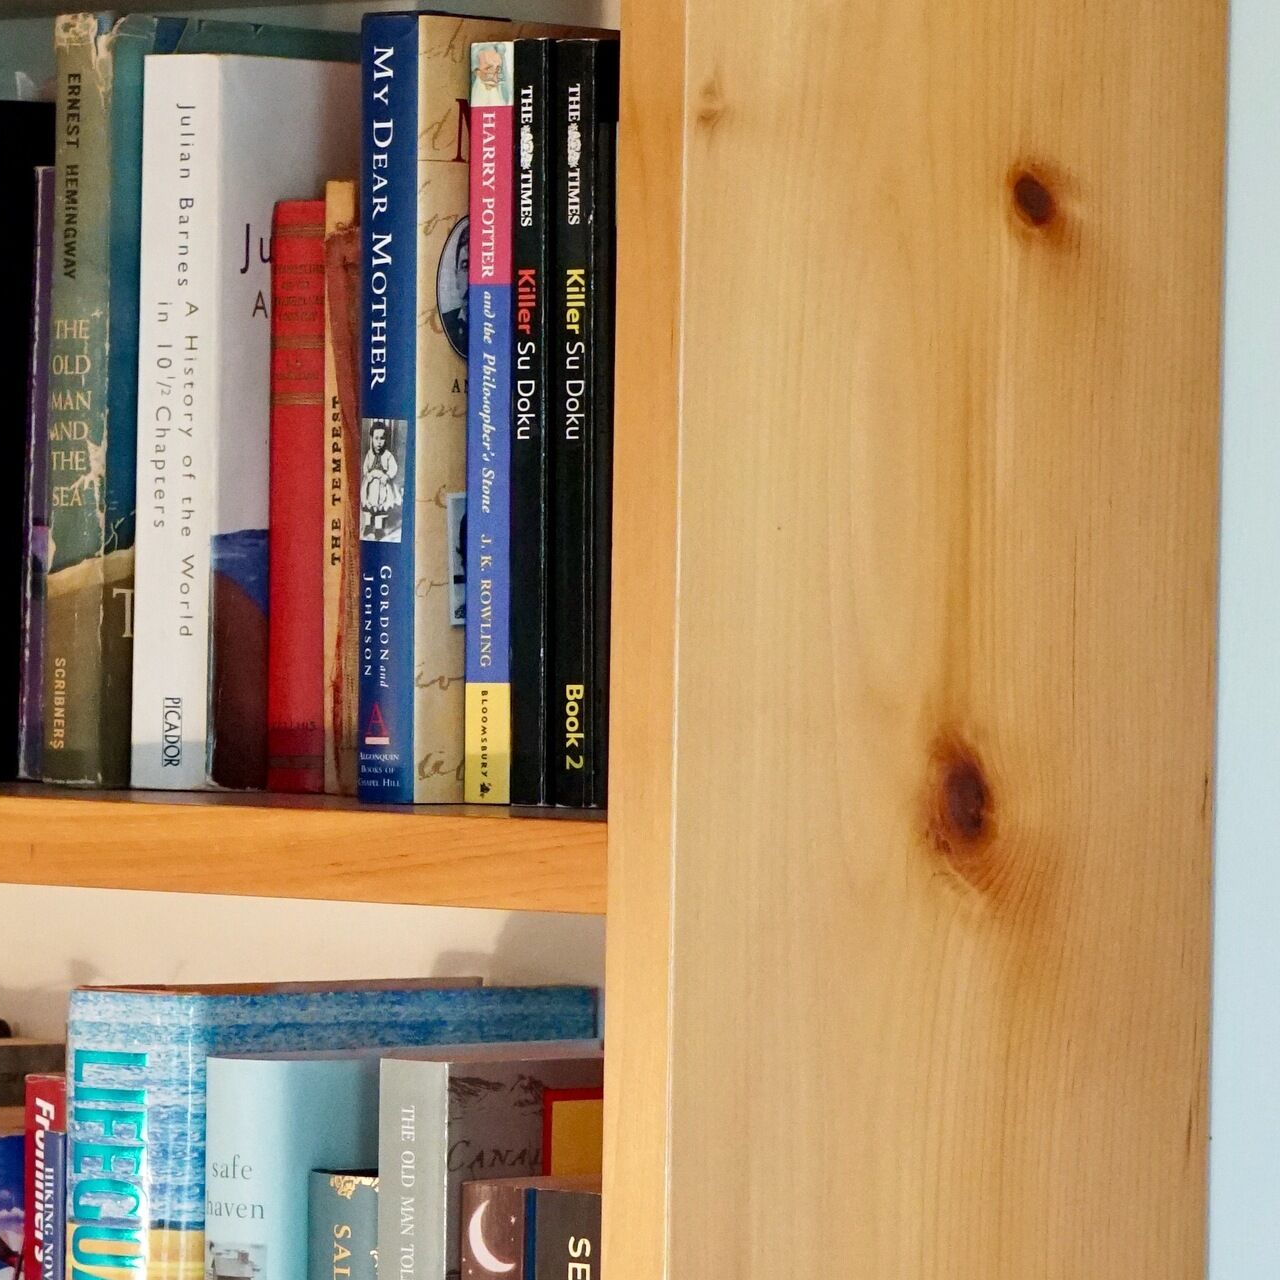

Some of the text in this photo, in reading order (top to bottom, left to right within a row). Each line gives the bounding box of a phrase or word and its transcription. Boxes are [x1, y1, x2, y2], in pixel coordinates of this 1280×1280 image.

[63, 72, 82, 280] ERNEST HEMINGWAY
[520, 84, 533, 227] THE TIMES
[567, 83, 581, 225] THE TIMES
[370, 45, 395, 390] MY DEAR MOTHER
[52, 354, 91, 376] OLD
[54, 318, 90, 340] THE
[516, 268, 537, 440] Killer Su Doku
[564, 268, 586, 440] Killer Su Doku
[51, 388, 92, 411] MAN
[176, 102, 200, 638] Julian Barnes A History of the World
[51, 450, 87, 472] THE
[51, 485, 83, 507] SEA
[330, 396, 343, 566] THE TEMPEST
[362, 572, 374, 677] JOHNSON
[378, 565, 392, 688] GORDON and
[162, 696, 181, 768] PICADOR
[480, 689, 490, 778] BLOOMSBURY
[565, 683, 585, 770] Book 2
[400, 1104, 416, 1142] THE
[42, 1166, 55, 1236] HIKING
[206, 1188, 266, 1220] haven
[211, 1154, 254, 1181] safe
[400, 1150, 416, 1188] OLD
[400, 1196, 415, 1236] MAN
